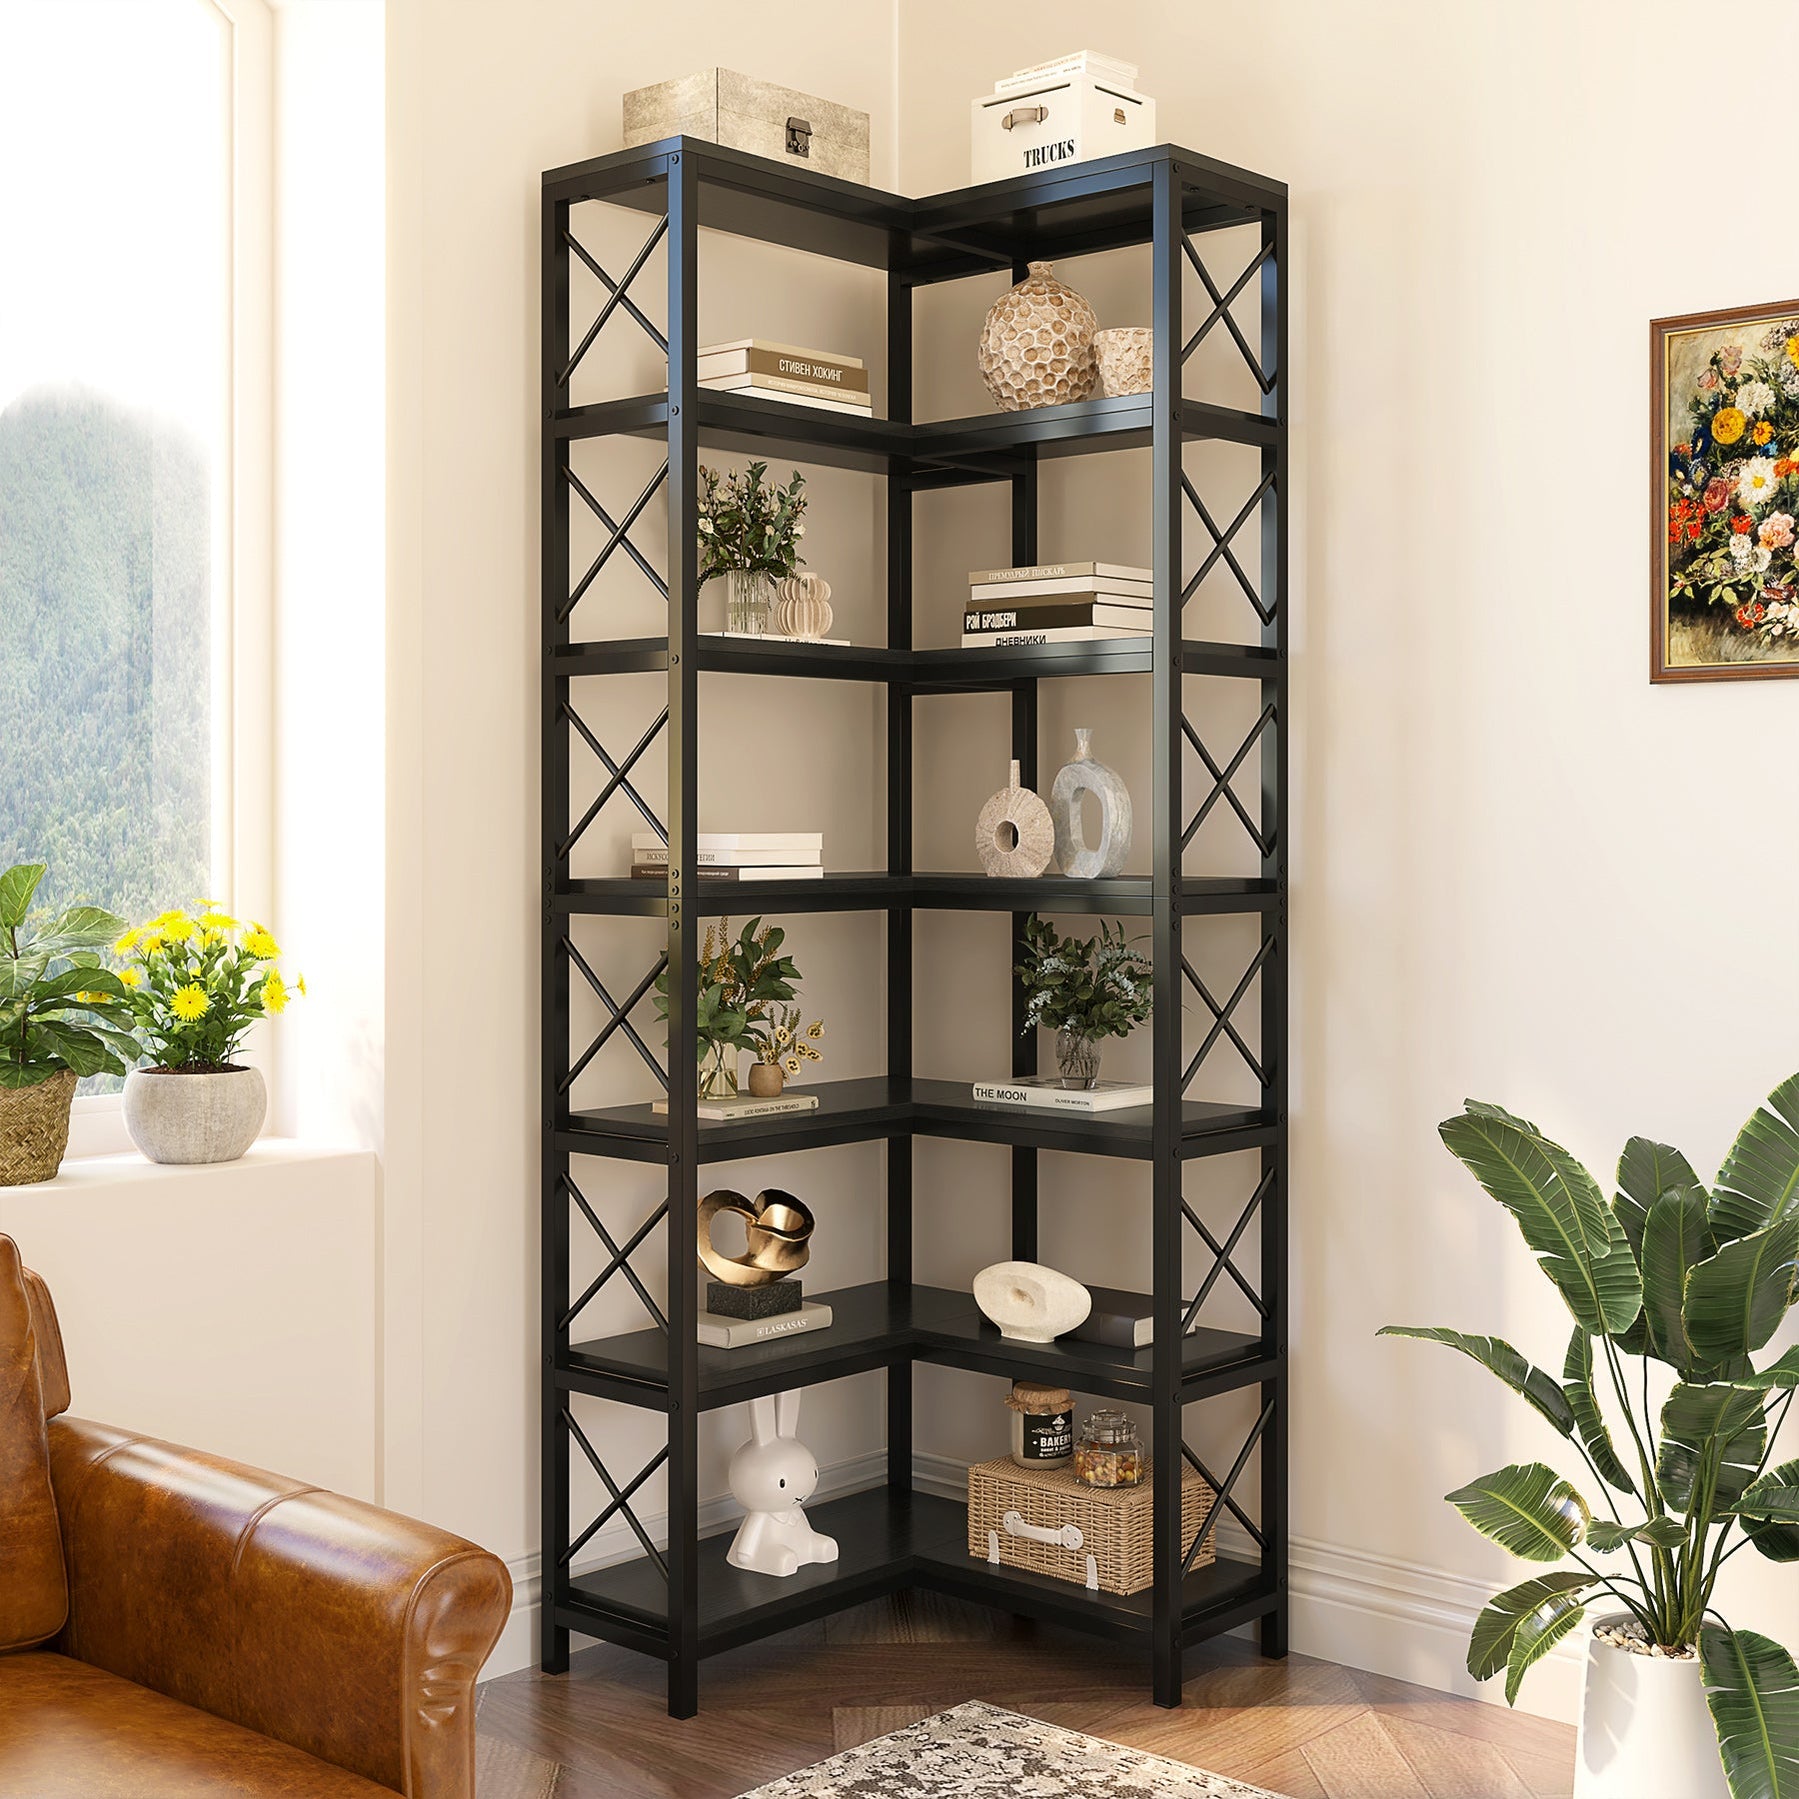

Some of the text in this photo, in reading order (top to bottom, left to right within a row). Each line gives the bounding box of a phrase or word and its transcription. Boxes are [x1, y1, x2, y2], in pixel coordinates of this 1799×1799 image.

[1023, 139, 1075, 168] TRUCKS
[779, 359, 843, 382] СТИВЕН ХОКИНГ
[966, 611, 1017, 630] РЭЙ БРЭДБЕРИ
[975, 1087, 1027, 1102] THE MOON
[765, 1319, 807, 1335] LASKASAS
